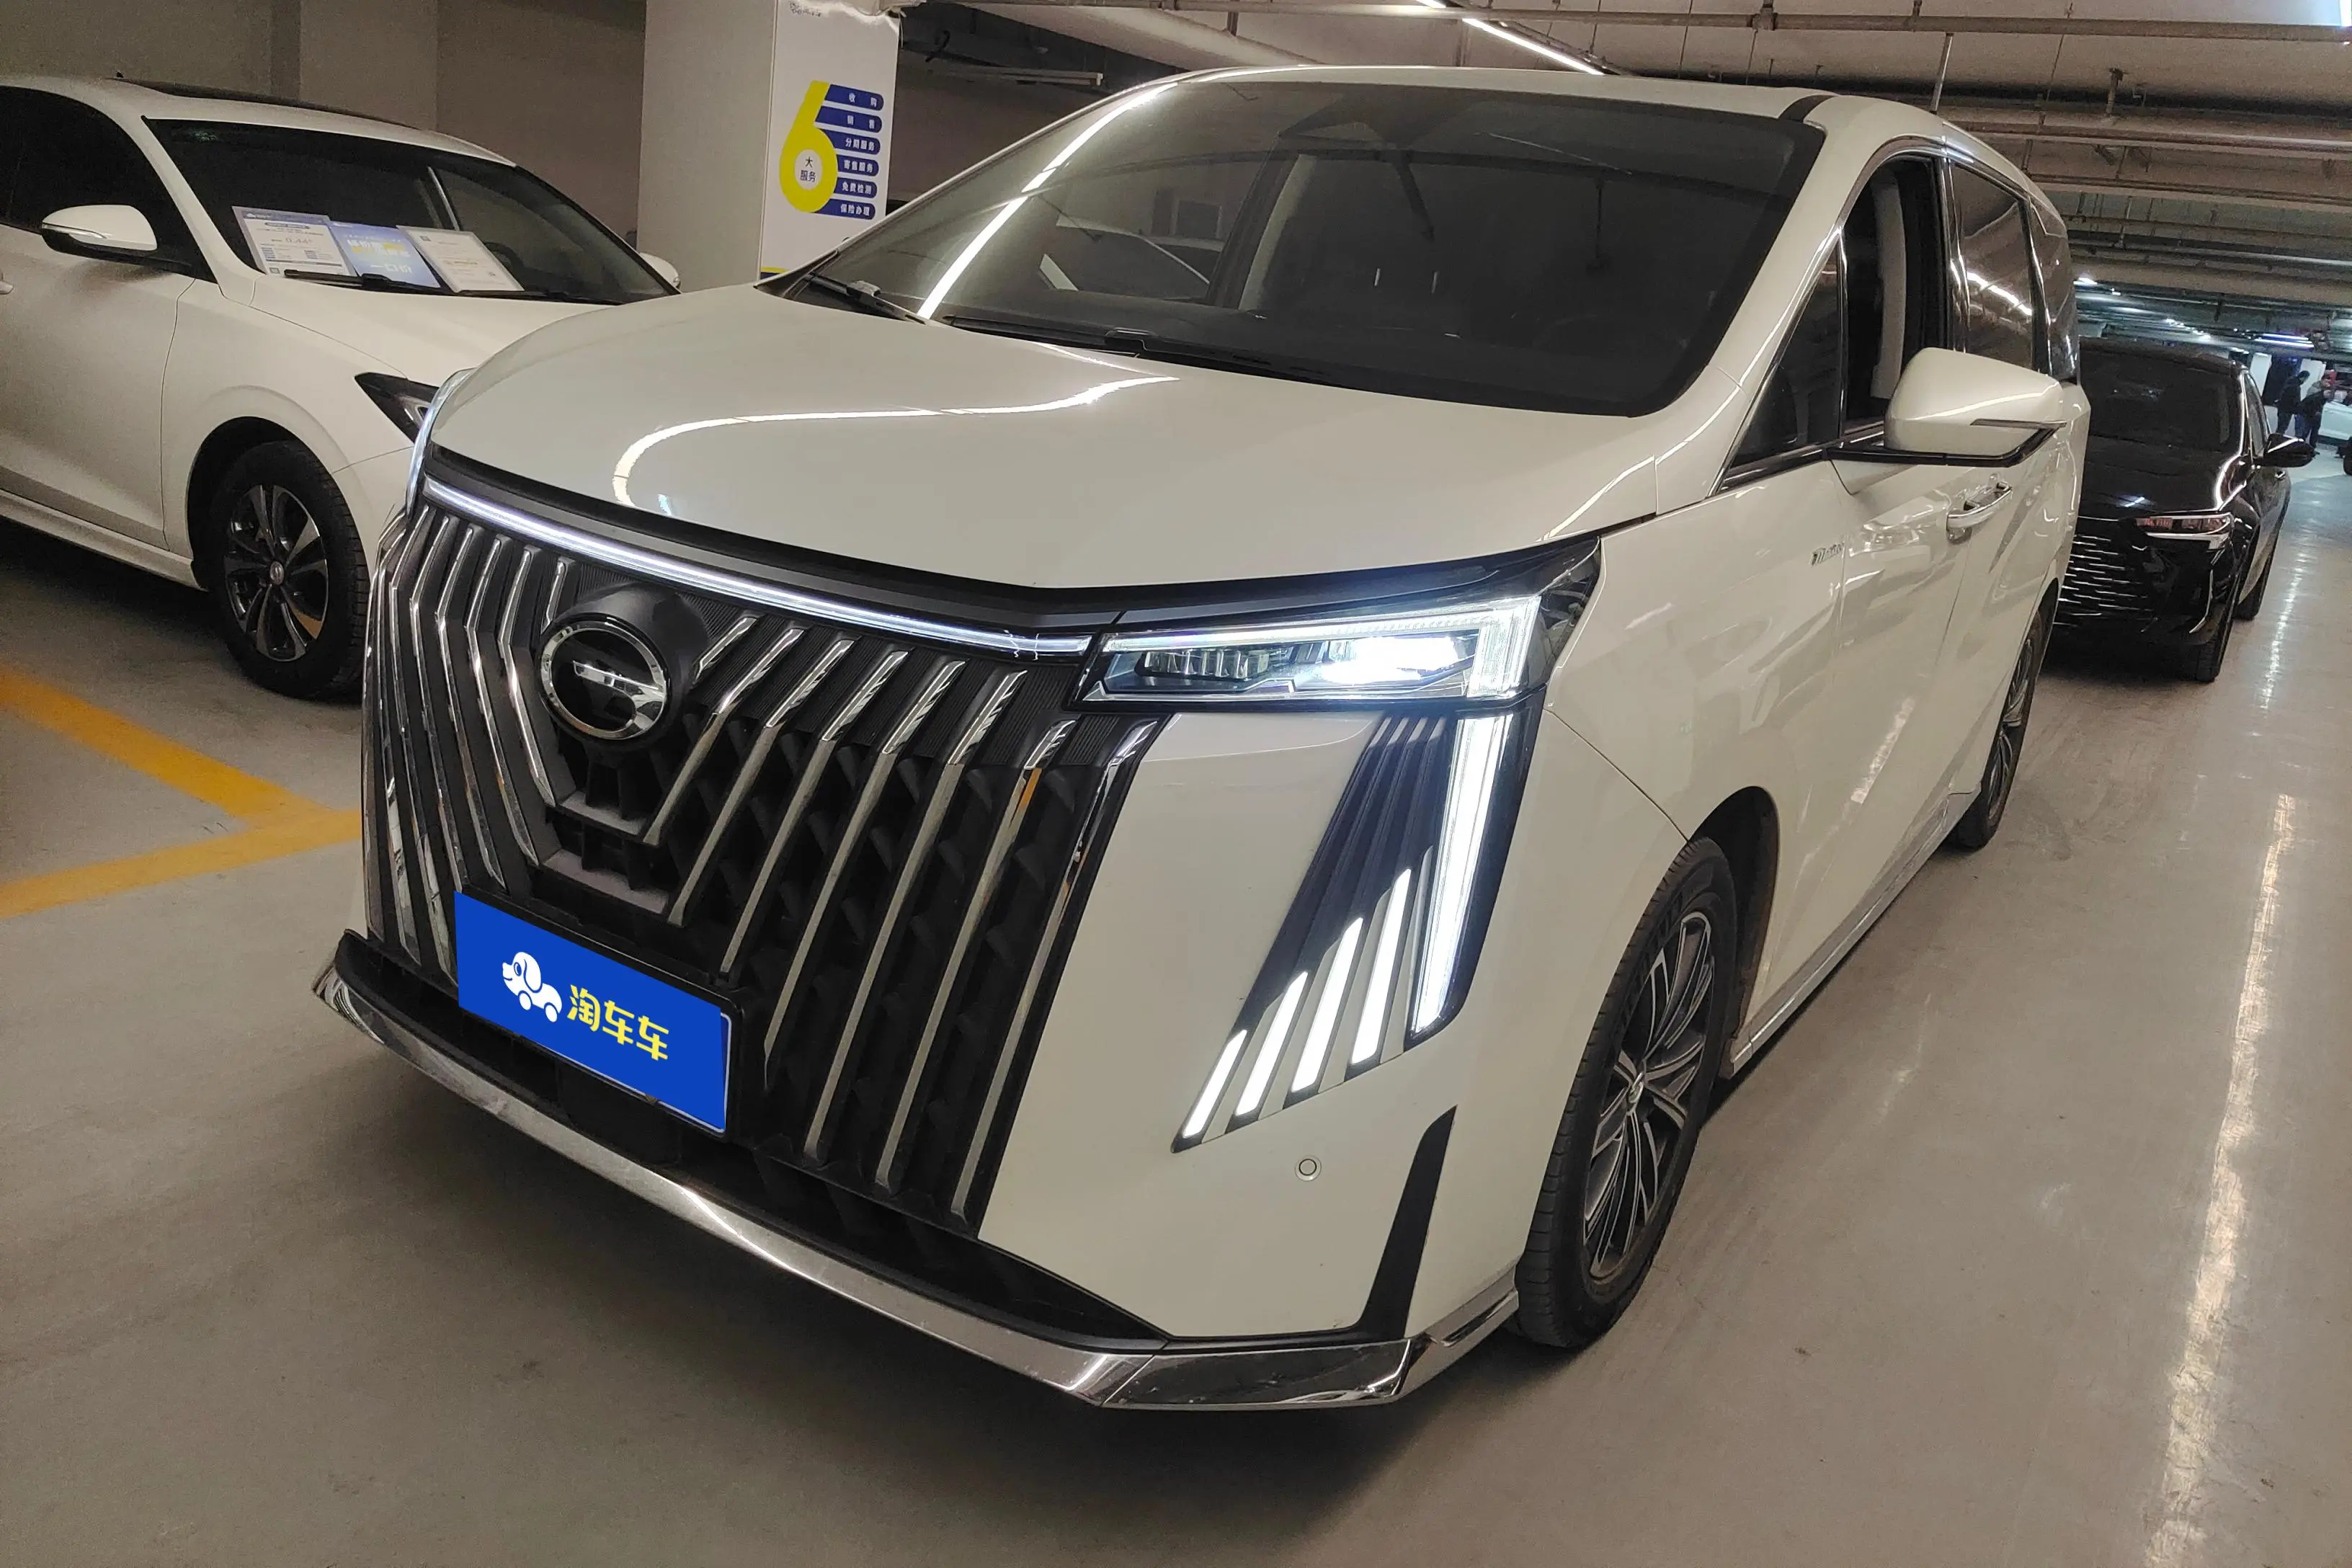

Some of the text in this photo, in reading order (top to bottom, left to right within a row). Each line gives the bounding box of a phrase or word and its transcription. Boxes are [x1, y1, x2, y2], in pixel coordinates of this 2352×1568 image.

[779, 80, 838, 213] 6
[845, 138, 875, 151] 分期服务
[805, 156, 813, 168] 大
[800, 170, 816, 182] 服务
[842, 182, 872, 195] 免费检测
[840, 204, 870, 216] 保险办理
